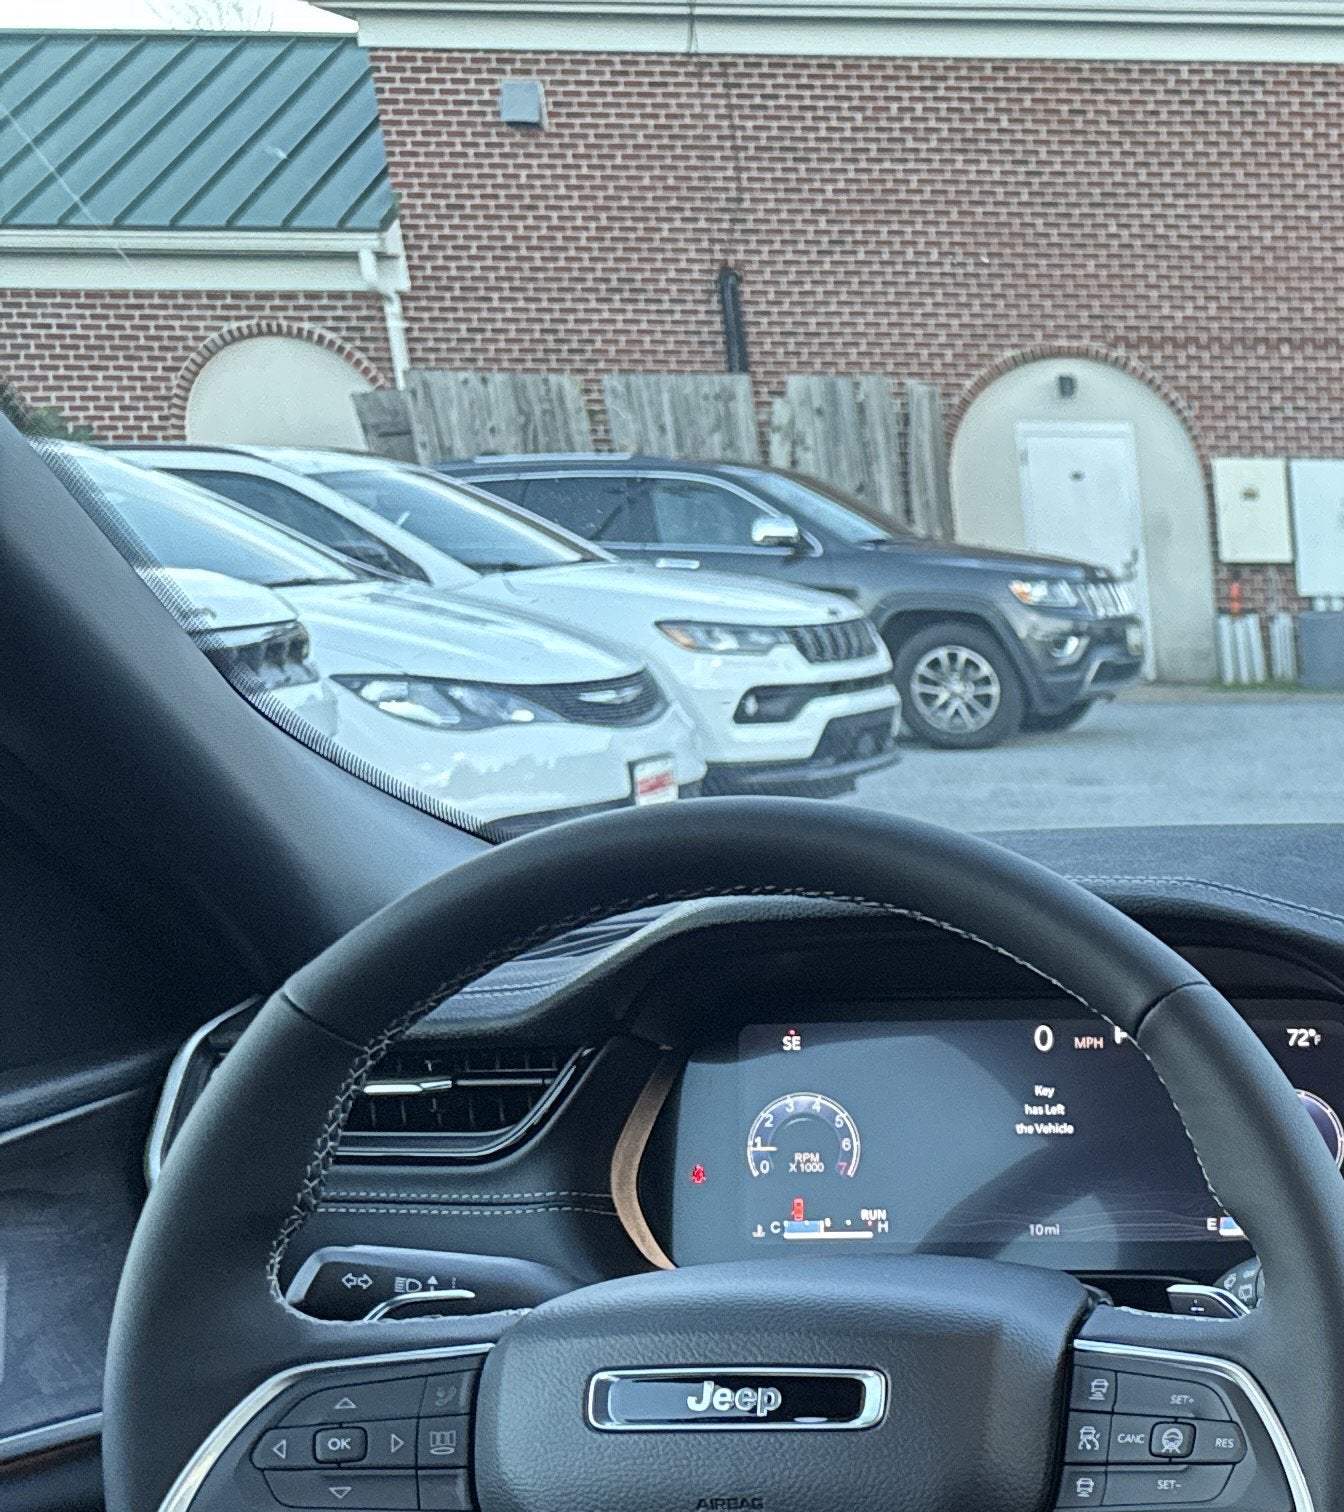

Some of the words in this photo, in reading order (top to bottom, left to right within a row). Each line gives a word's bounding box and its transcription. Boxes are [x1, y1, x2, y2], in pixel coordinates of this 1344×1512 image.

[782, 1035, 801, 1051] SE
[1034, 1025, 1054, 1052] 0
[1074, 1037, 1104, 1049] MPH
[1034, 1085, 1055, 1098] Key
[786, 1100, 794, 1112] 3
[812, 1100, 821, 1112] 4
[1024, 1104, 1044, 1116] has
[1045, 1104, 1066, 1116] Left
[764, 1115, 774, 1127] 2
[835, 1115, 844, 1128] 5
[1015, 1123, 1034, 1134] the
[1034, 1123, 1074, 1135] Vehicle
[841, 1138, 851, 1150] 6
[794, 1152, 820, 1162] RPM
[760, 1160, 769, 1174] 0
[799, 1163, 824, 1172] 1000
[860, 1209, 886, 1220] RUN
[770, 1221, 781, 1234] C
[1207, 1217, 1218, 1231] E
[687, 1380, 782, 1417] Jeep
[328, 1438, 351, 1450] OK
[1117, 1433, 1145, 1445] CANC
[1215, 1438, 1234, 1449] RES
[696, 1498, 764, 1511] AIRBAG
